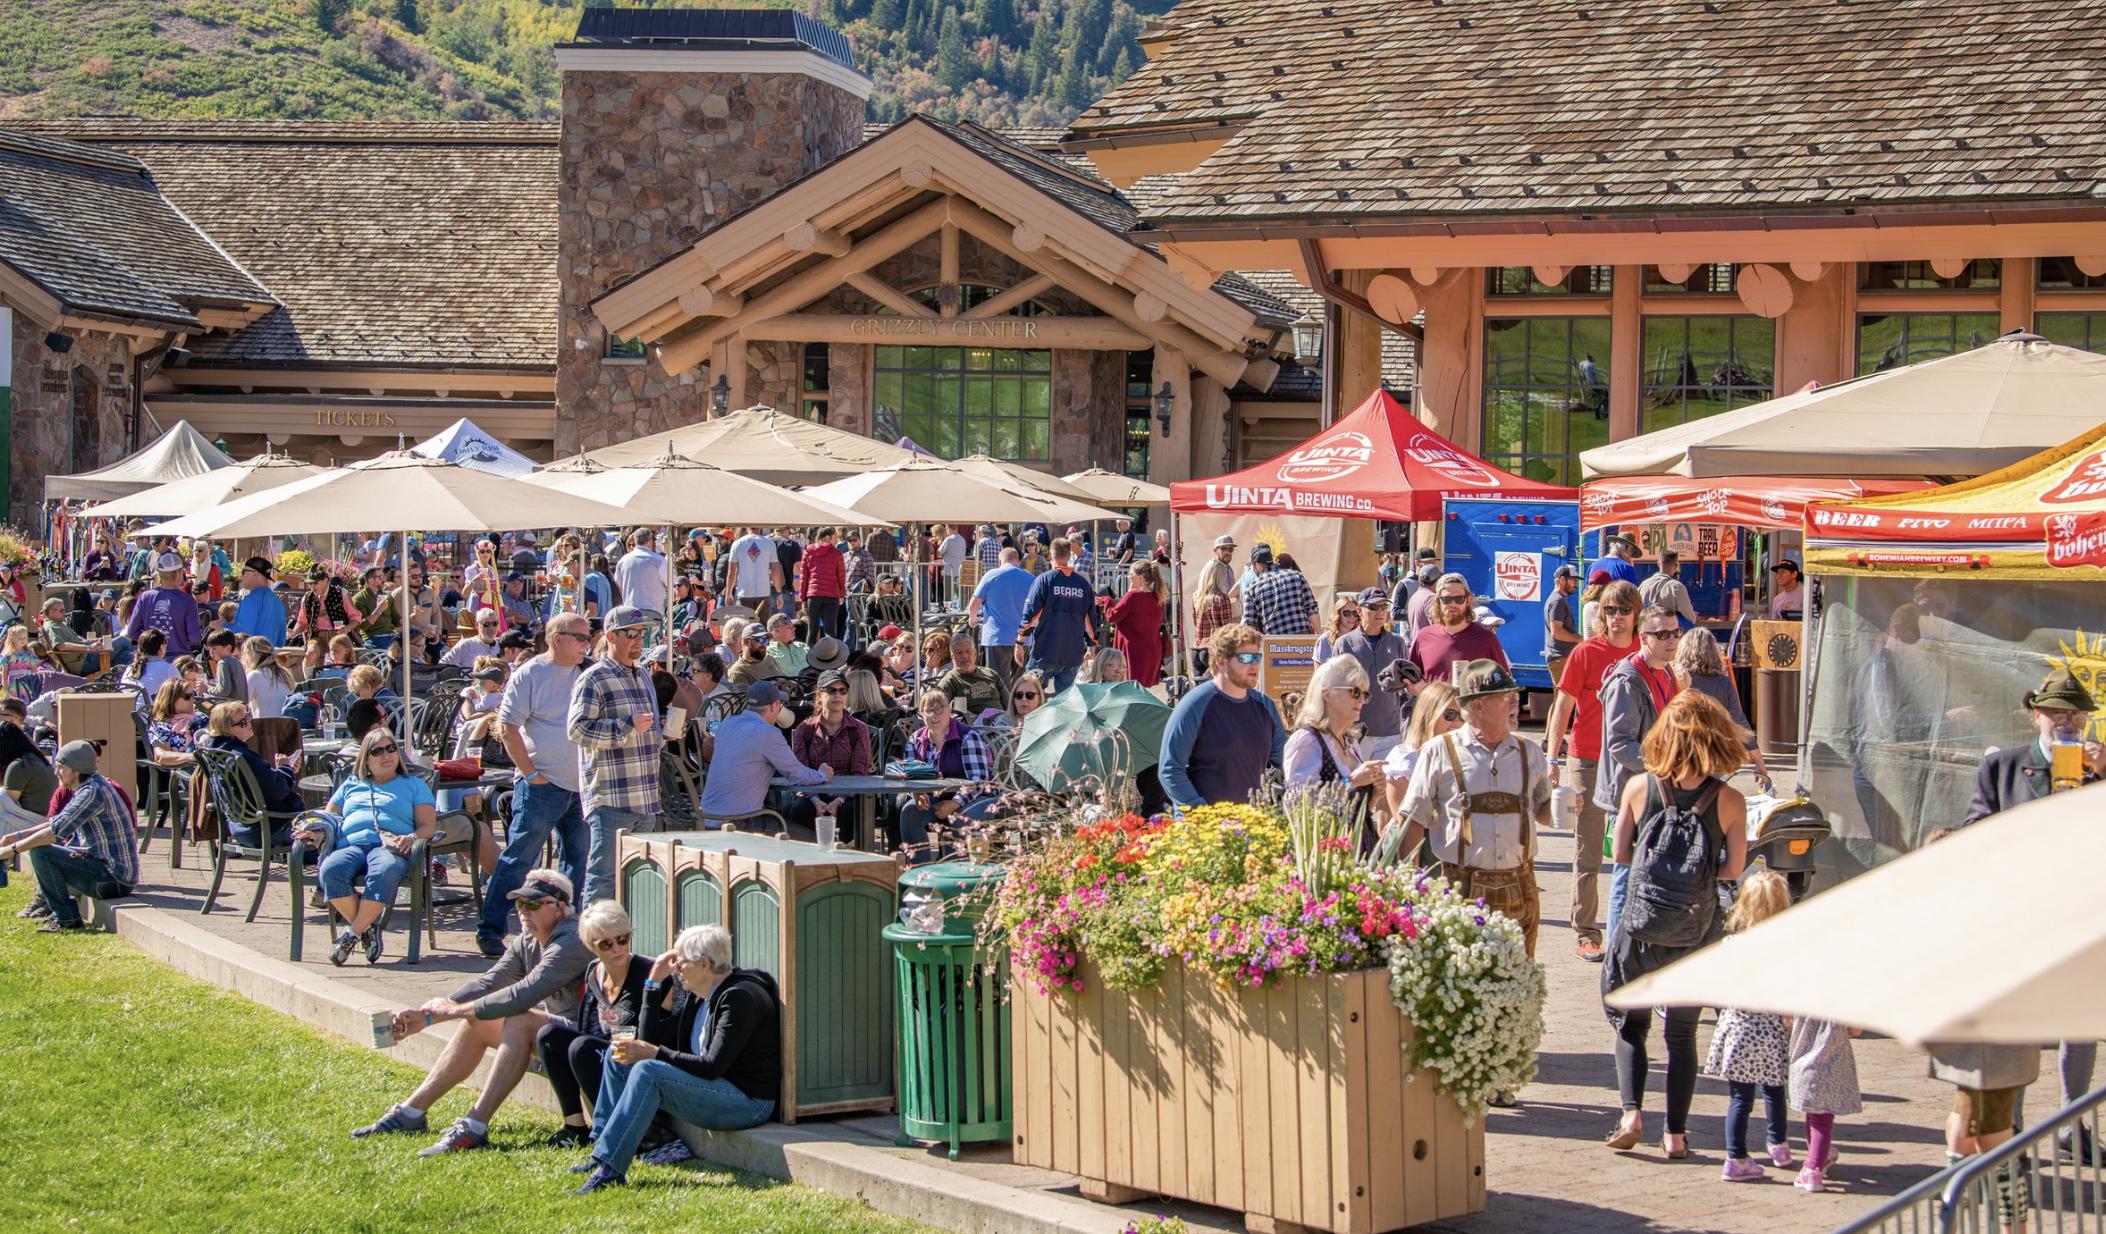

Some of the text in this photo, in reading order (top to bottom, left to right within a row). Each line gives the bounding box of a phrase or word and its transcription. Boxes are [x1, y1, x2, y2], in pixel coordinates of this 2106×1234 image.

[851, 318, 1037, 338] GRIZZLY CENTER
[314, 409, 395, 427] TICKETS
[1288, 447, 1373, 463] UINTA
[1404, 448, 1476, 463] UINTA
[1290, 465, 1342, 473] BREWING
[1206, 484, 1375, 510] UINTA BREWING CO.
[1696, 487, 1733, 508] SHOCK
[1705, 500, 1728, 516] TOP
[1814, 510, 1951, 528] BEER PIVO
[1648, 529, 1667, 555] IPA
[1699, 528, 1718, 542] TRAIL
[1698, 541, 1718, 556] BEER
[1869, 554, 1968, 563] BOHEMIANBREWERY.COM
[1497, 563, 1538, 576] UINTA
[1053, 586, 1084, 598] BEARS
